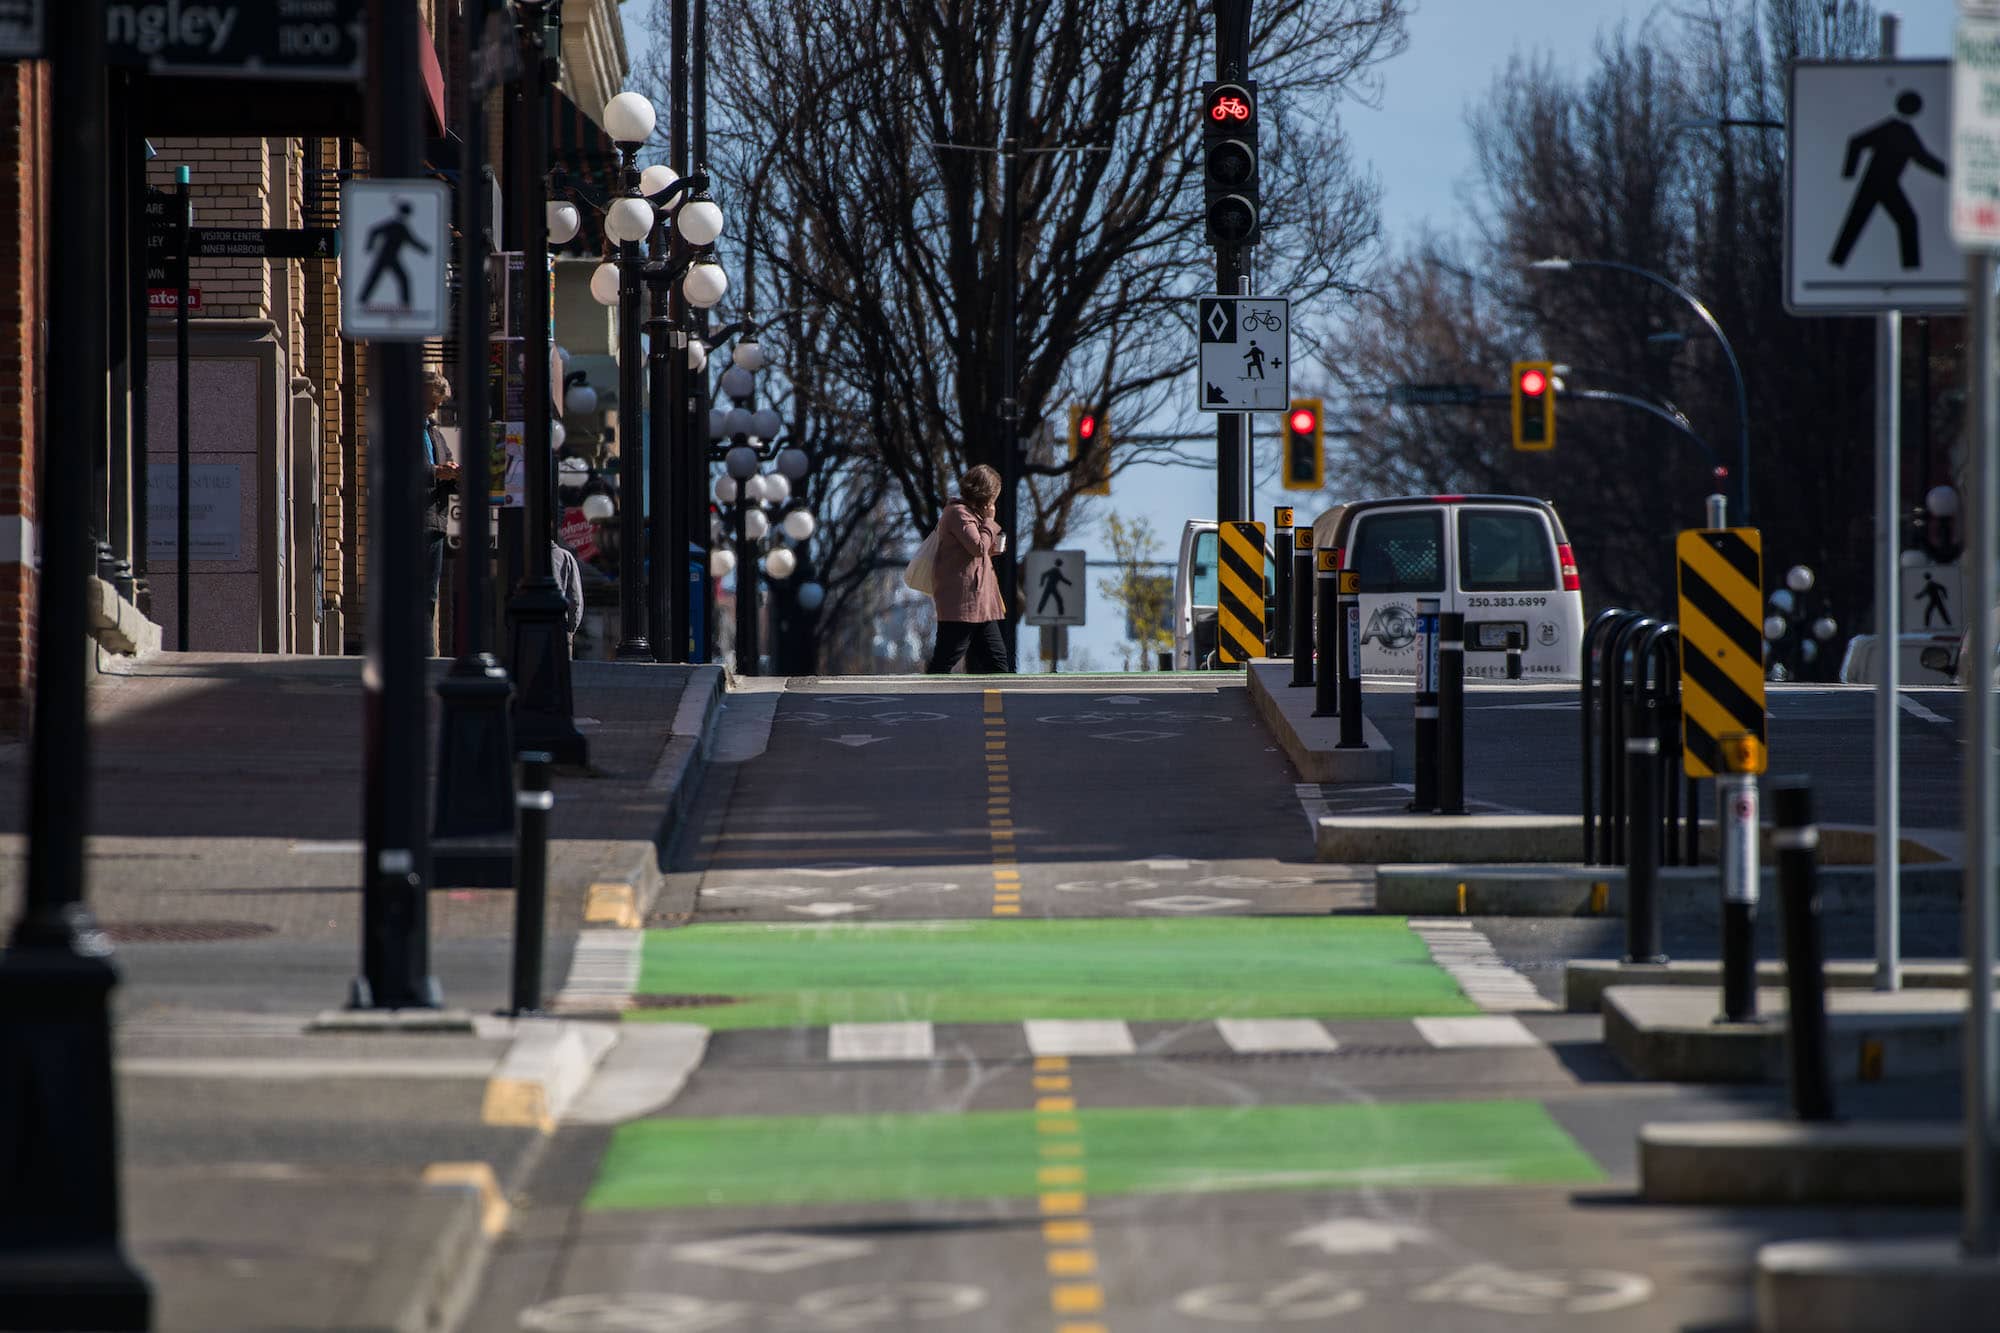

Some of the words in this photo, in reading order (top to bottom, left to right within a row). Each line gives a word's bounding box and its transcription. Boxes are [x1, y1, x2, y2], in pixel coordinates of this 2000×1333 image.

[200, 231, 231, 242] VISITOR
[200, 244, 225, 254] INNER
[227, 244, 265, 255] HARBOUR
[150, 290, 196, 305] aton
[1468, 597, 1546, 607] 250.383.6899
